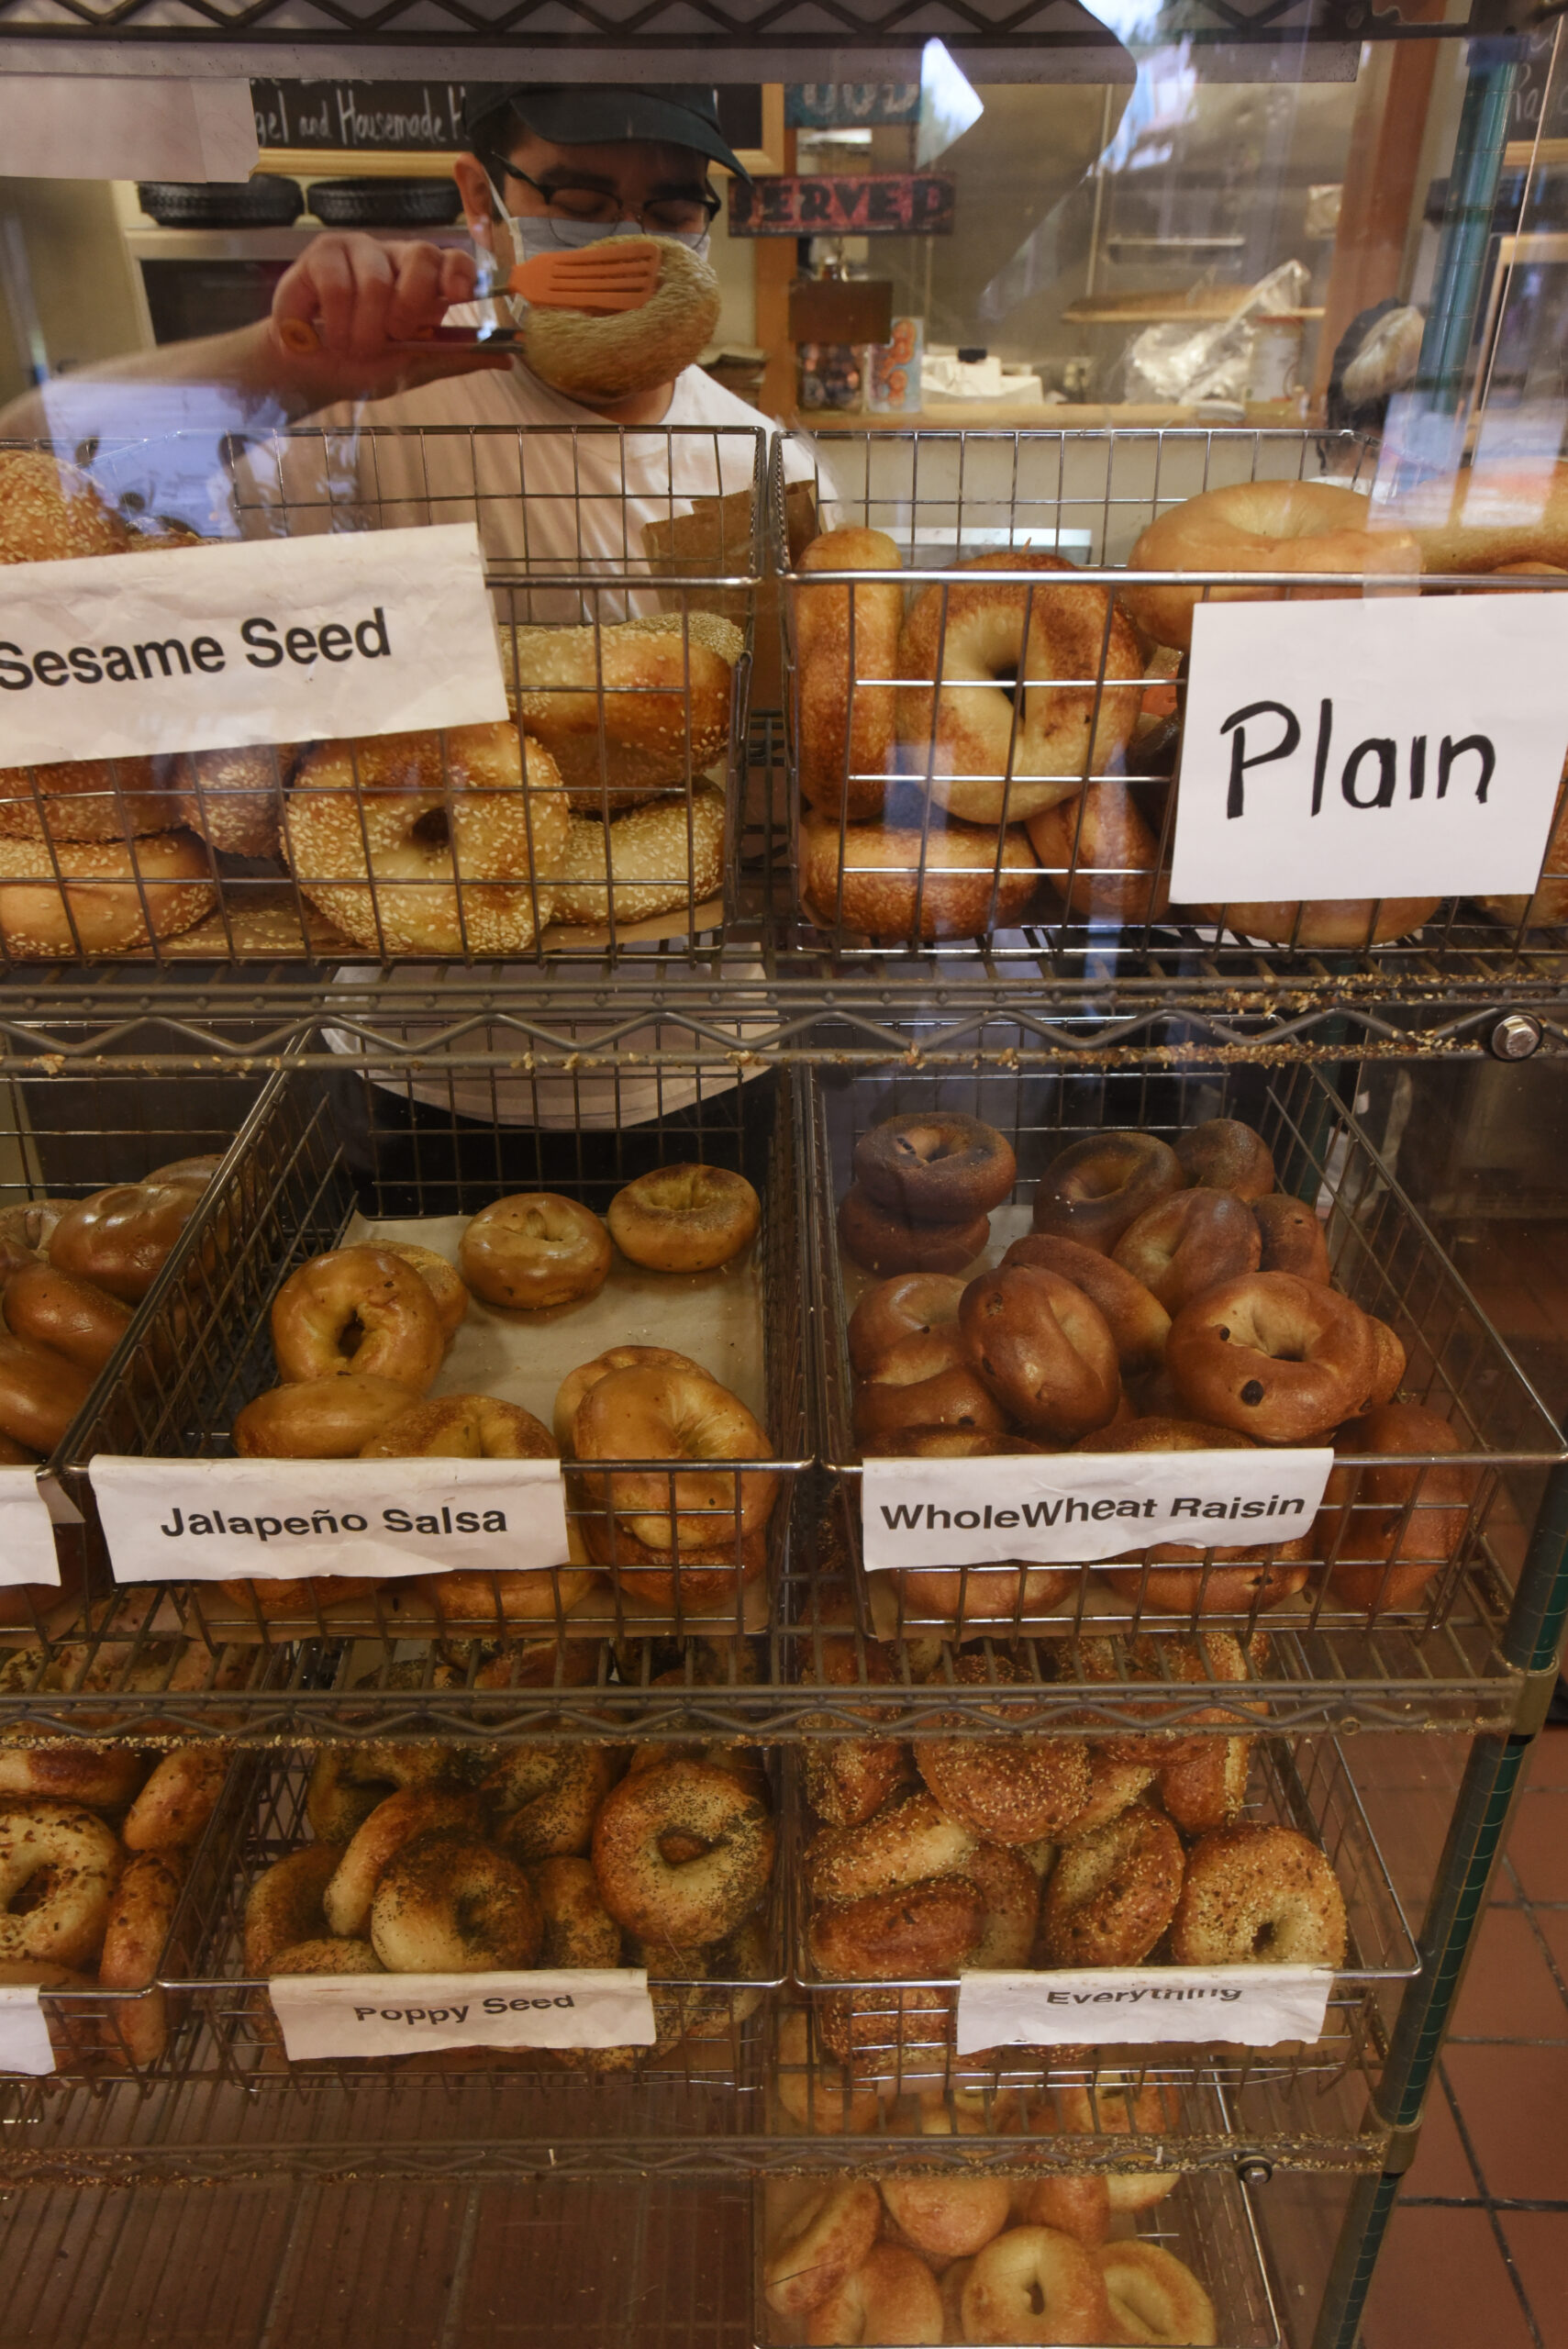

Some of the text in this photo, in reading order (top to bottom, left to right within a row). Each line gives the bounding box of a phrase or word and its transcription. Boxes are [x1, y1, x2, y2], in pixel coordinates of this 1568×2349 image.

[0, 607, 393, 690] Sesame Seed
[1220, 697, 1496, 819] Plain
[161, 1507, 508, 1541] Jalapeño Salsa
[880, 1494, 1305, 1530] WholeWheat Raisin
[353, 1994, 575, 2025] Poppy Seed
